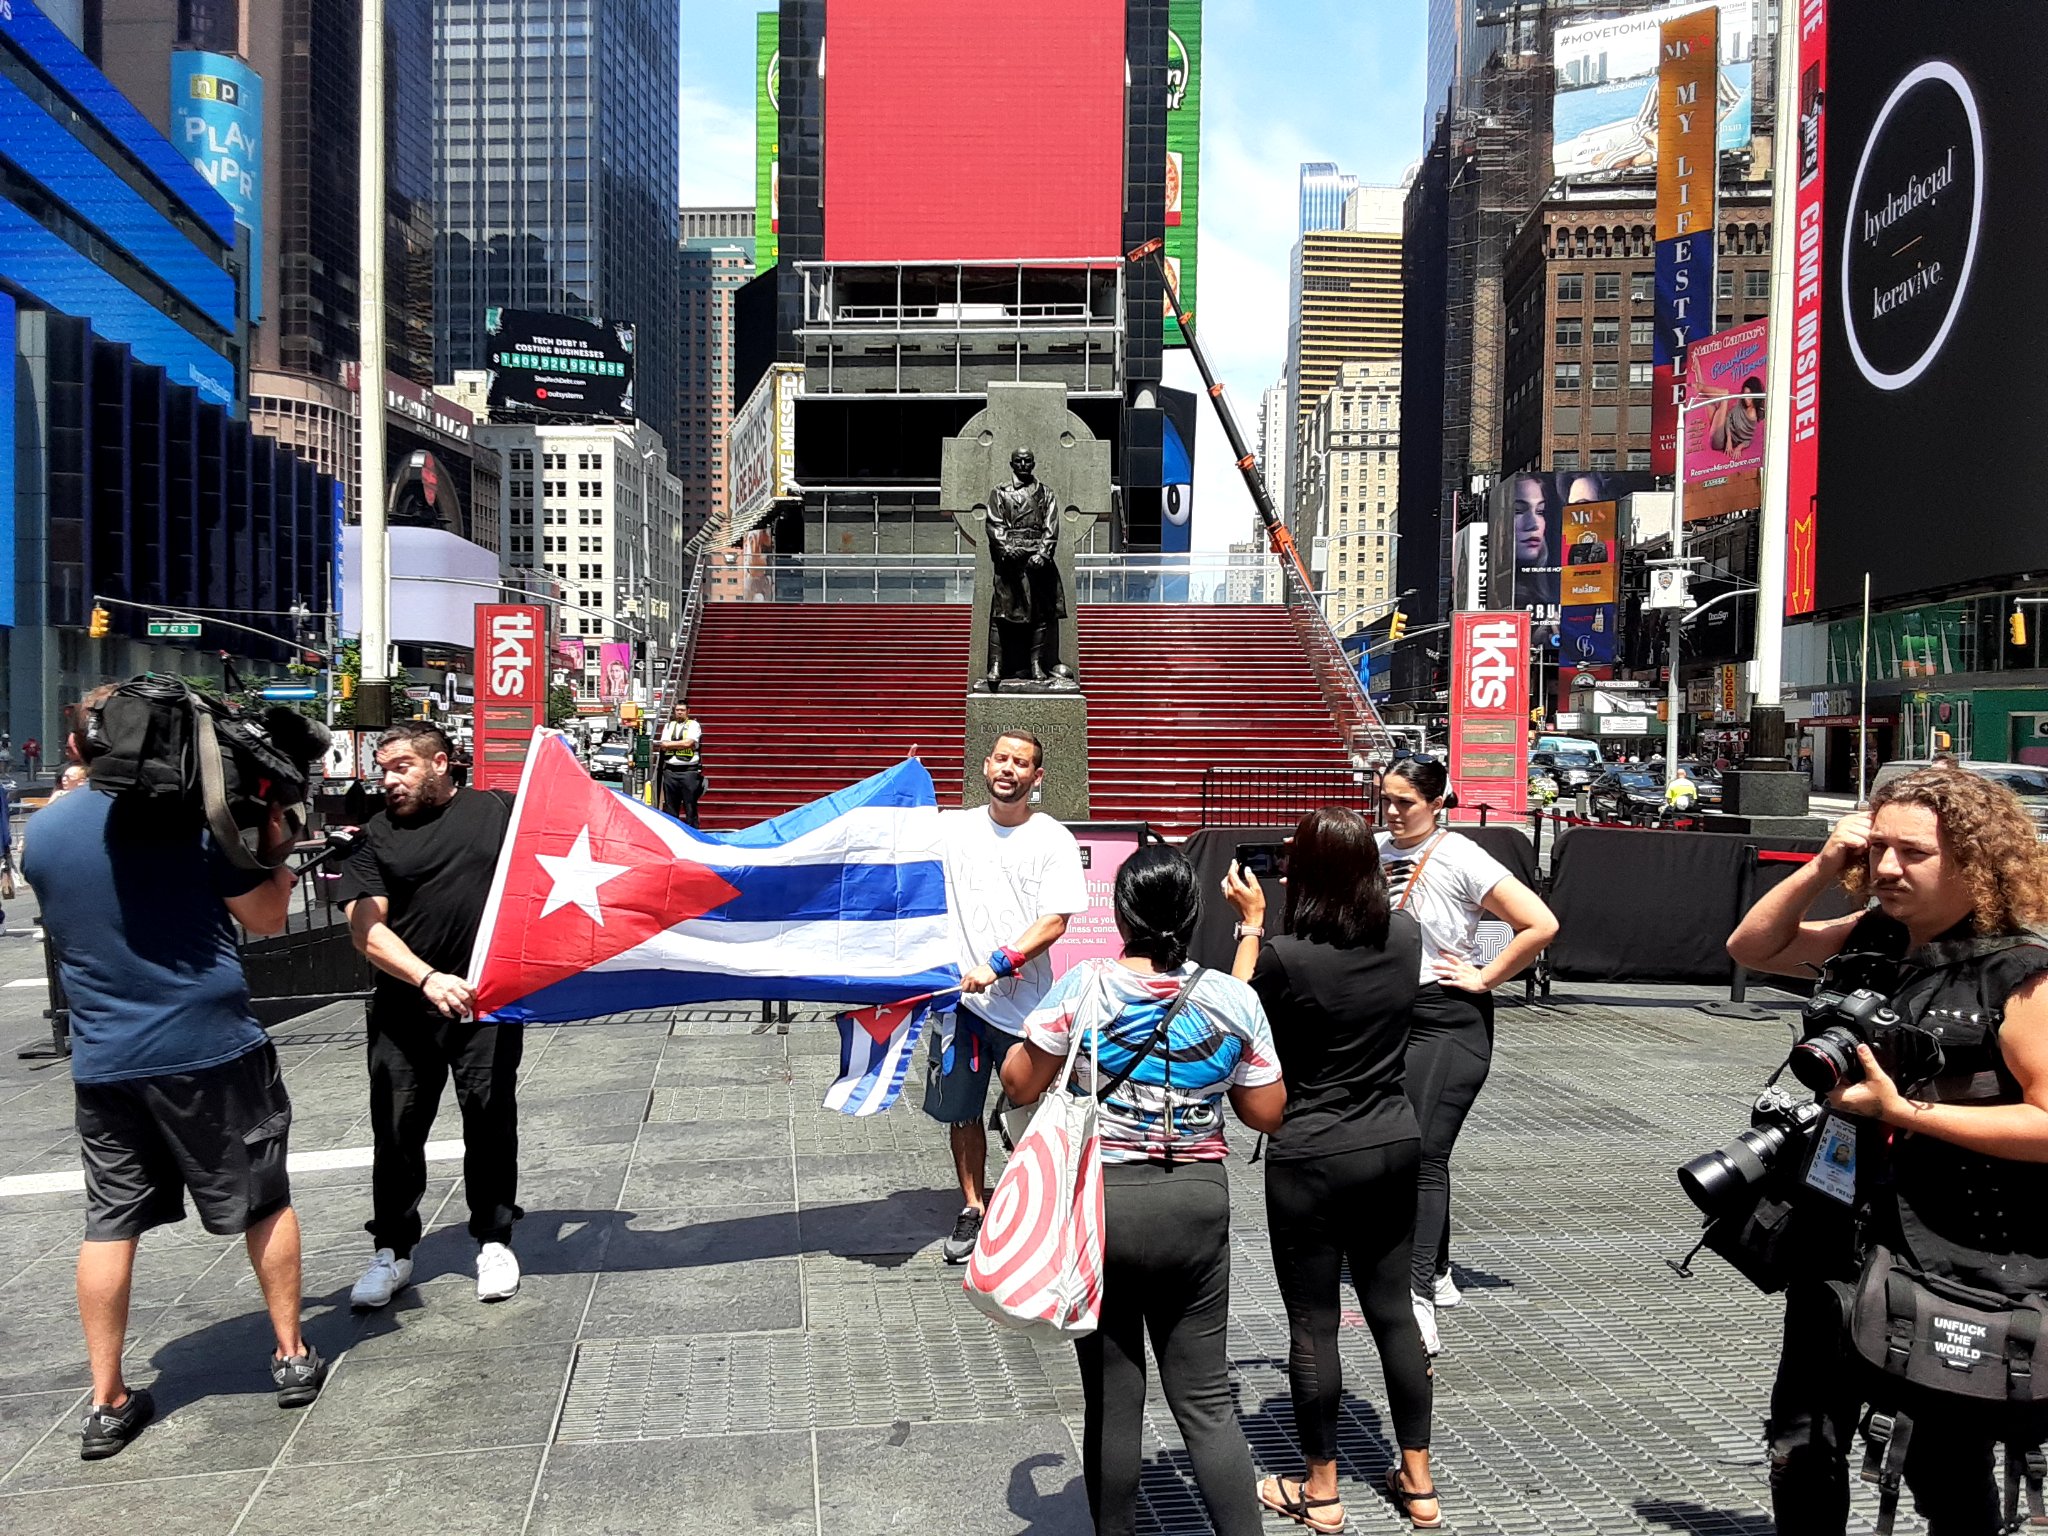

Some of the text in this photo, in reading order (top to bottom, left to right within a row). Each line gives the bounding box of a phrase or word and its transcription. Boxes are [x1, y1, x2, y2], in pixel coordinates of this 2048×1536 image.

[1863, 147, 1953, 247] hydrafacial
[1872, 260, 1941, 319] keravive
[532, 336, 588, 349] TECH DEBT IS
[1795, 201, 1820, 443] COME INSIDE!
[515, 343, 605, 359] COSTING BUSINESSES
[492, 612, 534, 697] tkts
[1470, 620, 1517, 709] tkts
[1934, 1316, 1988, 1339] UNFUCK
[1945, 1331, 1972, 1347] THE
[1934, 1341, 1981, 1360] WORLD
